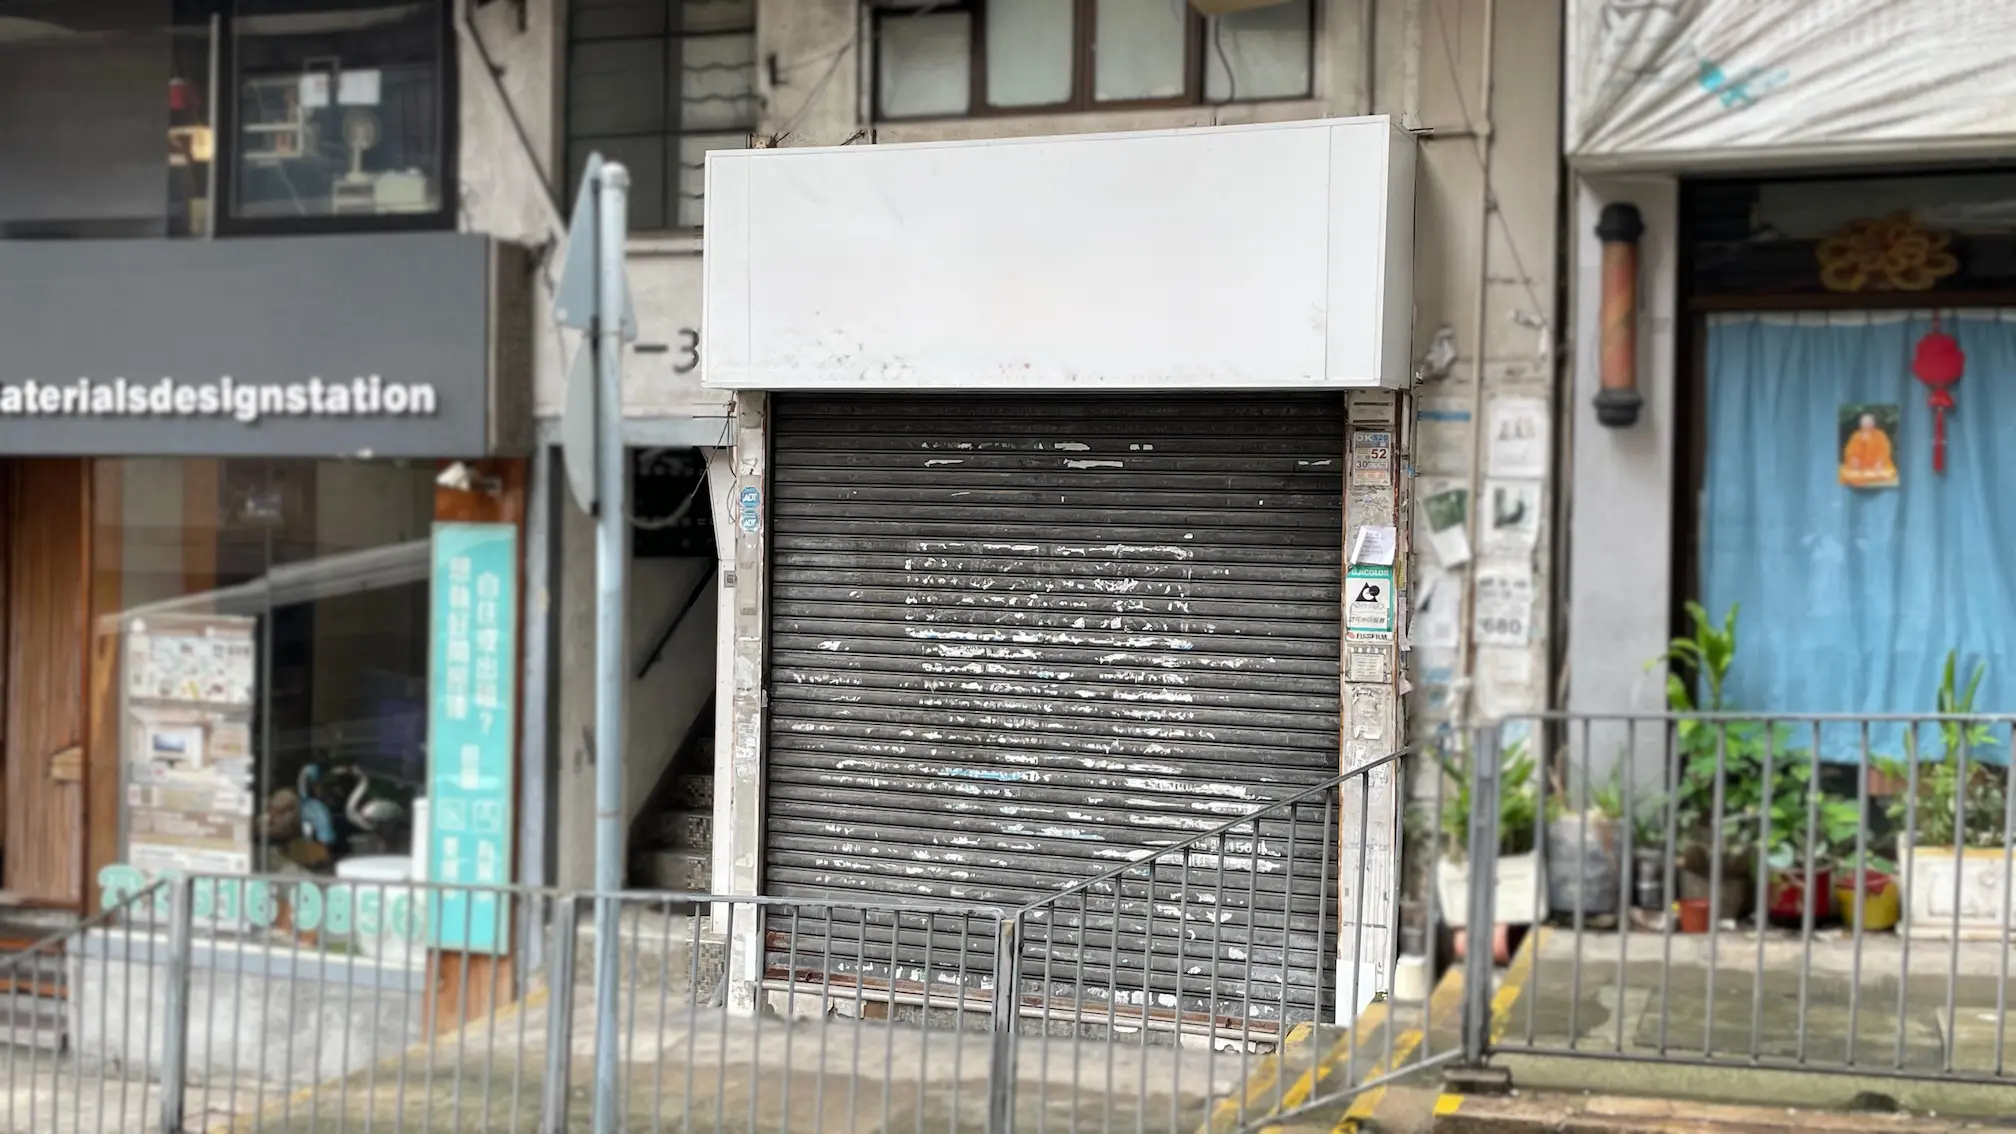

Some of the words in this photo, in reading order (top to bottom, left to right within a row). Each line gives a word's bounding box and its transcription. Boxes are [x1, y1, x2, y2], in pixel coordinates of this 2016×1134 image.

[1371, 448, 1387, 459] 52
[1356, 461, 1368, 469] 30
[742, 493, 758, 501] ADT
[1350, 569, 1389, 577] UJICOLOR
